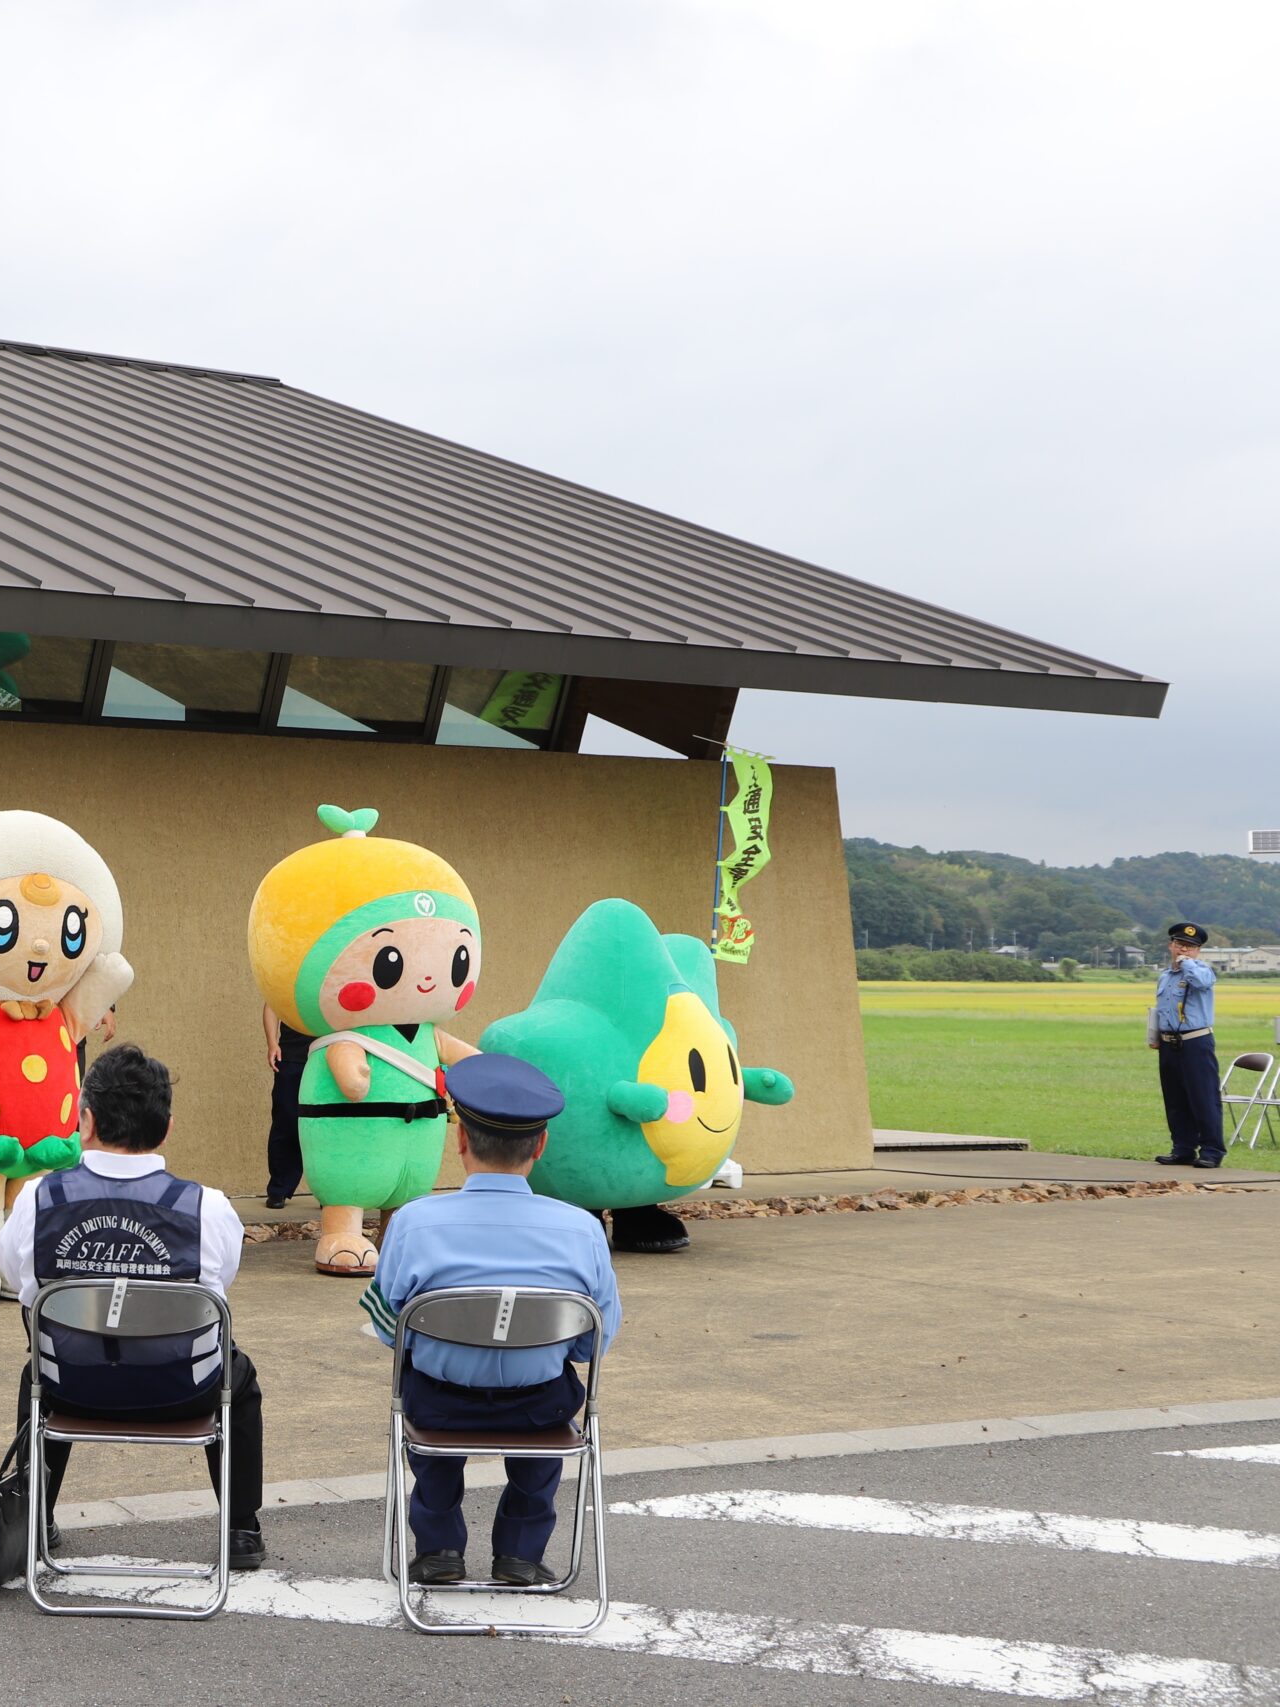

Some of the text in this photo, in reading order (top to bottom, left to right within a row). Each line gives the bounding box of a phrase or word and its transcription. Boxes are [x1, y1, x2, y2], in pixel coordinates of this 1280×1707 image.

[55, 1215, 171, 1261] SAFETY DRIVING MANAGEMENT
[77, 1241, 145, 1262] STAFF
